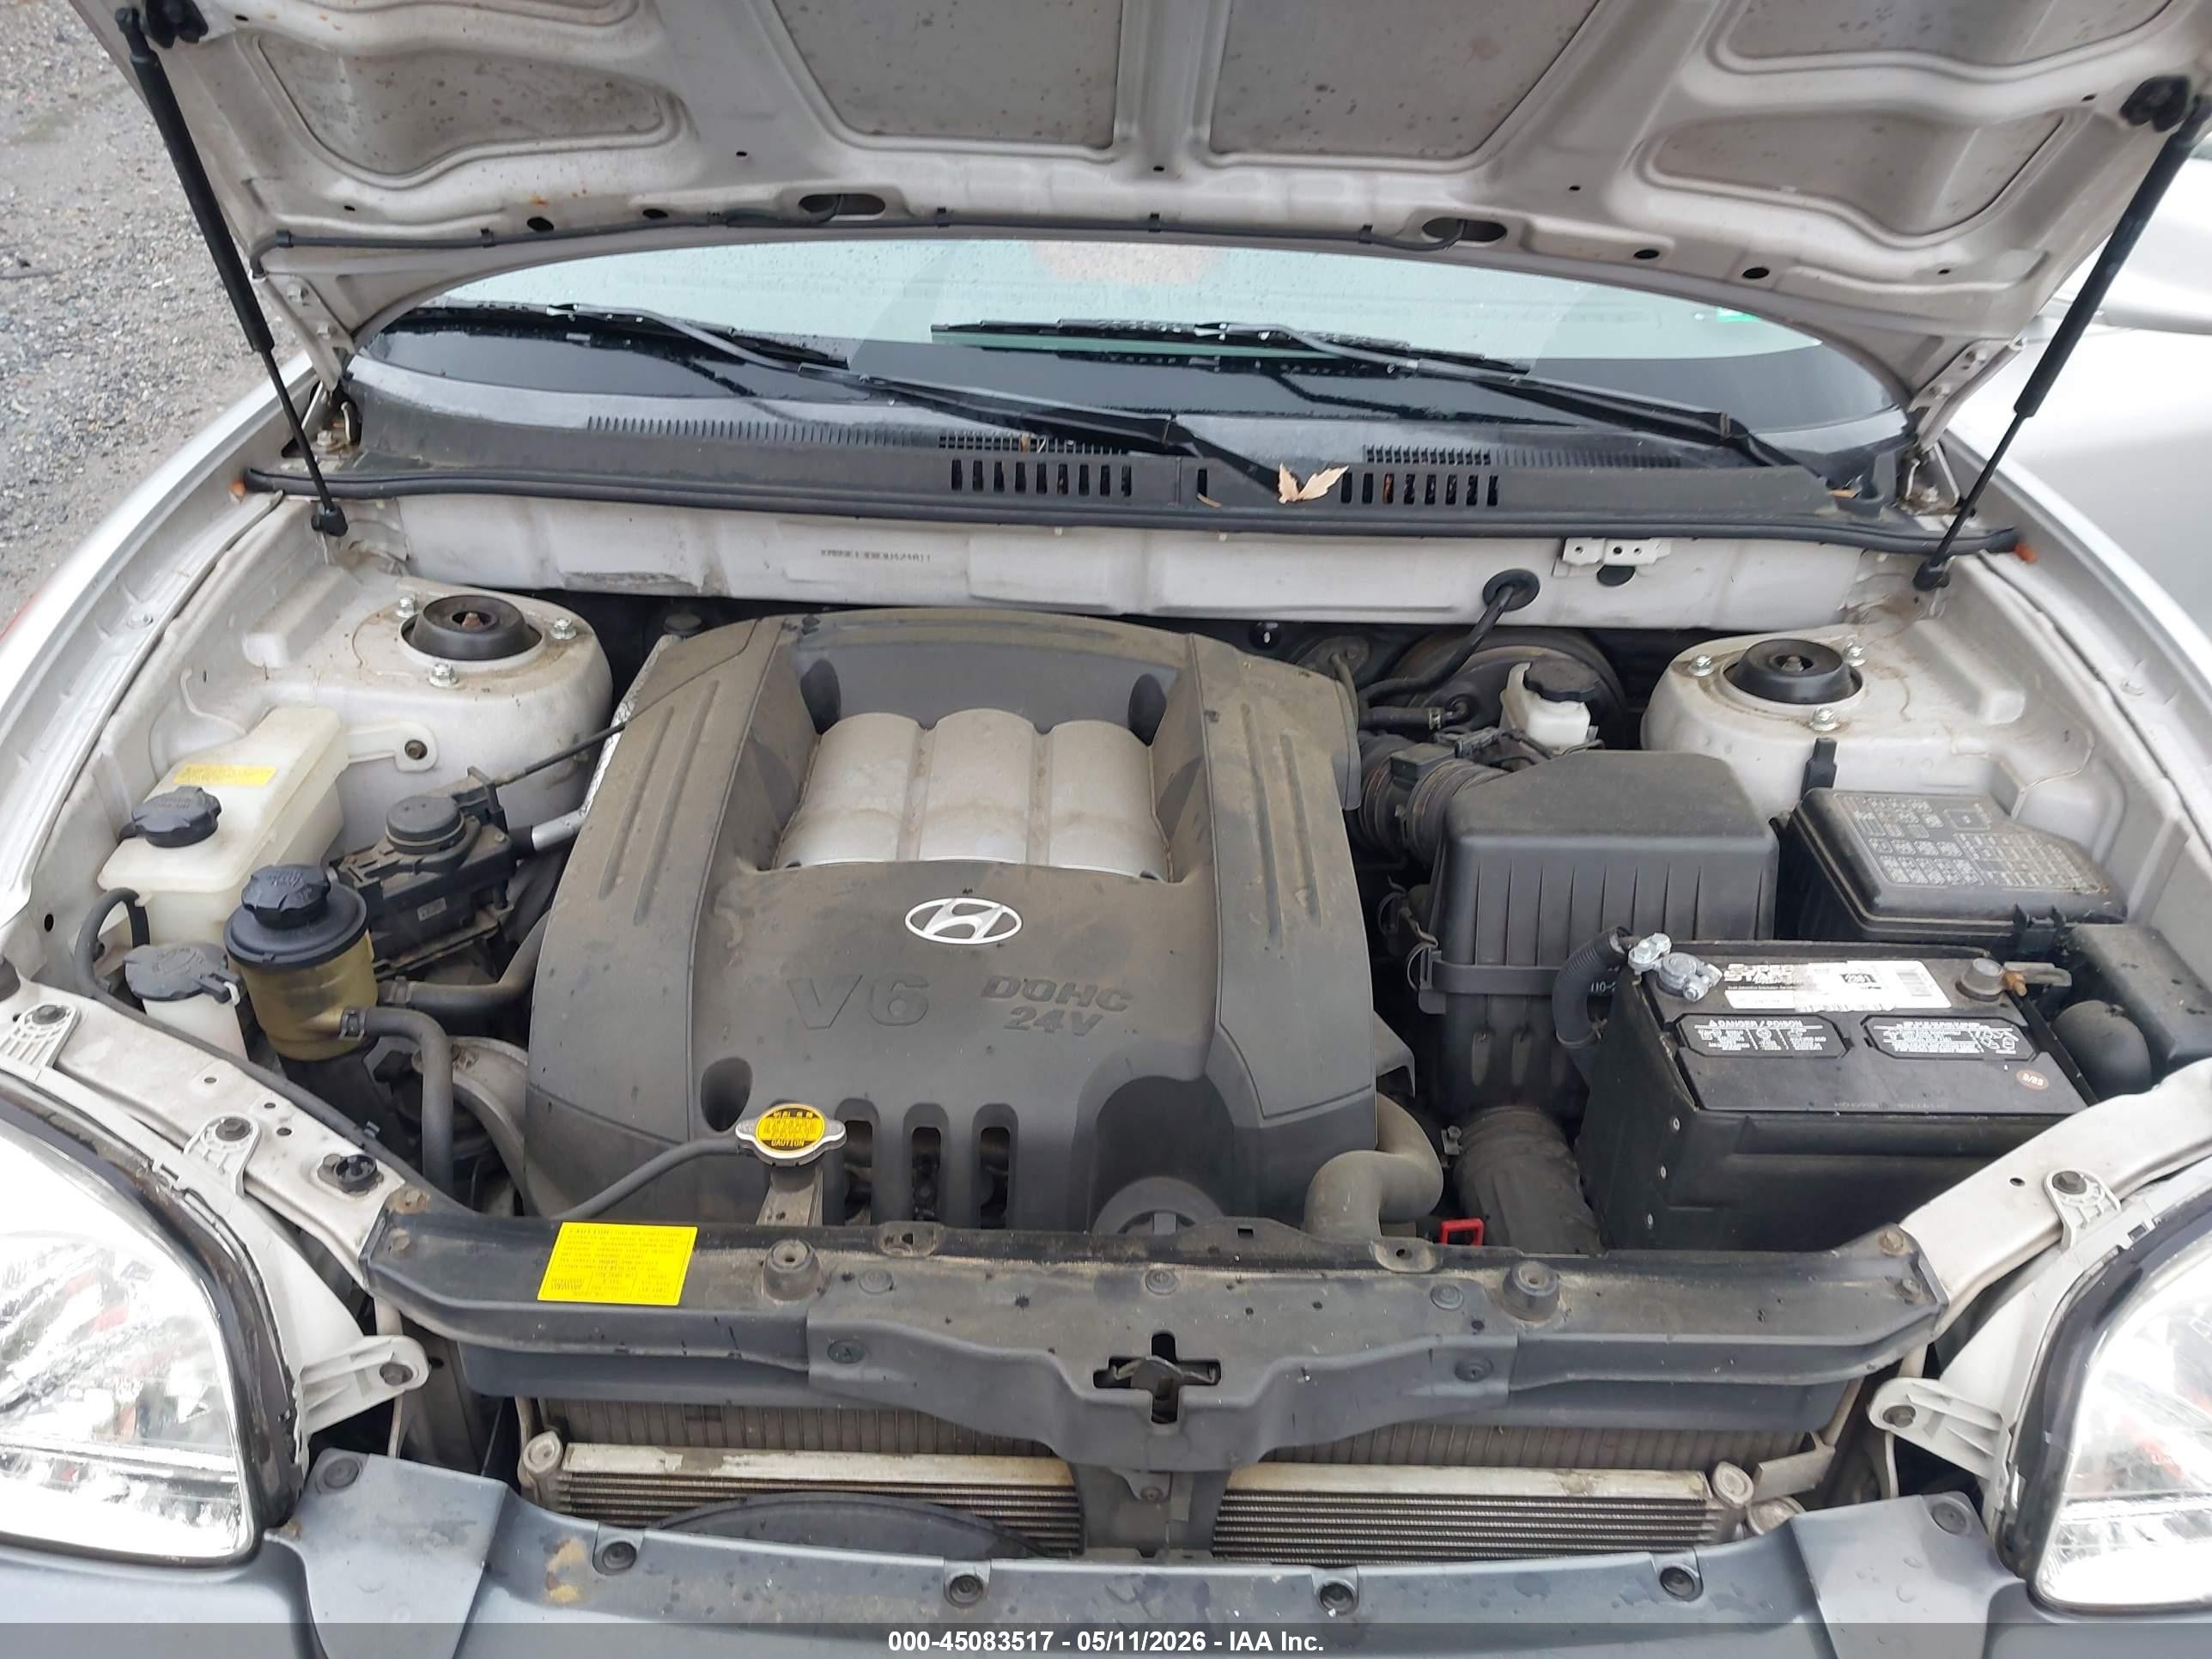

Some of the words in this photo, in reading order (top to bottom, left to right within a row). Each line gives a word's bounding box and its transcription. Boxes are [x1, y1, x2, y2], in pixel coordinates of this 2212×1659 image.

[787, 974, 929, 1028] V6
[981, 975, 1133, 1012] DOHC
[1003, 1006, 1104, 1036] 24V
[1717, 1019, 1759, 1029] DANGER
[1766, 1019, 1803, 1029] POISON
[771, 1139, 805, 1147] CAUTION
